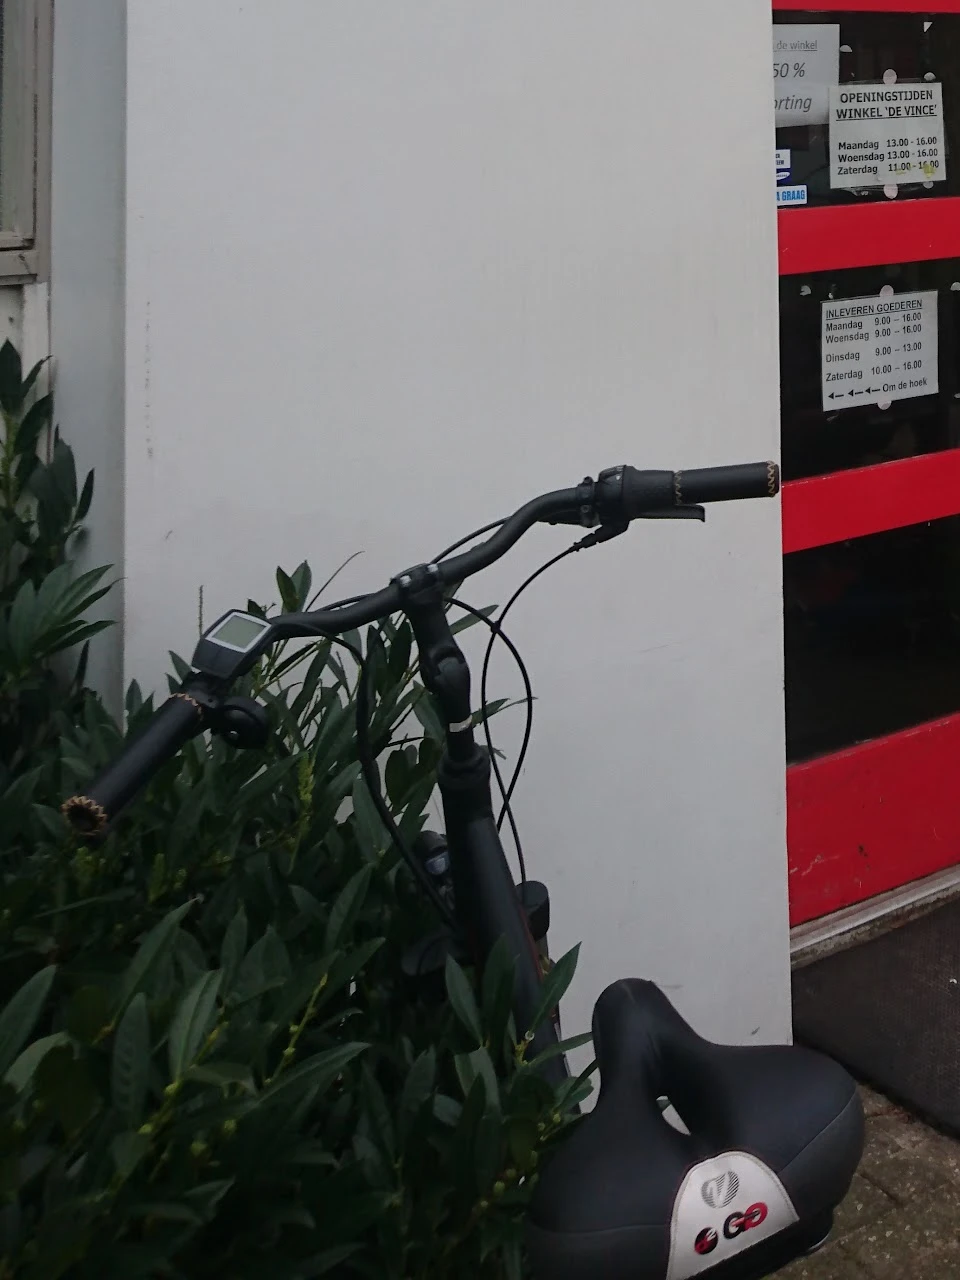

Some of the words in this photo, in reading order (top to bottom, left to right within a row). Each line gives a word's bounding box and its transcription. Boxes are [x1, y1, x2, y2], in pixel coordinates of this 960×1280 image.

[790, 40, 818, 50] winkel
[773, 62, 790, 78] 50
[793, 62, 806, 78] %
[840, 90, 933, 104] OPENINGSTIJDEN
[836, 107, 883, 119] WINKEL
[838, 140, 879, 151] Maandag
[886, 138, 909, 148] 13.00
[916, 136, 938, 146] 16.00
[838, 152, 885, 162] Woensdag
[887, 150, 910, 160] 13.00
[917, 148, 939, 158] 16.00
[838, 165, 878, 175] Zaterdag
[782, 189, 806, 201] GRAAG
[826, 304, 875, 319] INLEVEREN
[877, 300, 923, 312] GOEDEREN
[825, 321, 863, 332] Maandag
[874, 315, 891, 326] 9.00
[902, 312, 922, 322] 16.00
[825, 331, 870, 344] Woensdag
[874, 327, 891, 338] 9.00
[902, 323, 922, 334] 16.00
[825, 351, 860, 363] Dinsdag
[875, 346, 892, 356] 9.00
[902, 341, 922, 352] 13.00
[825, 370, 863, 382] Zaterdag
[871, 364, 892, 375] 10.00
[903, 359, 922, 370] 16.00
[882, 383, 896, 393] Om
[898, 381, 908, 390] de
[909, 377, 928, 388] hoek
